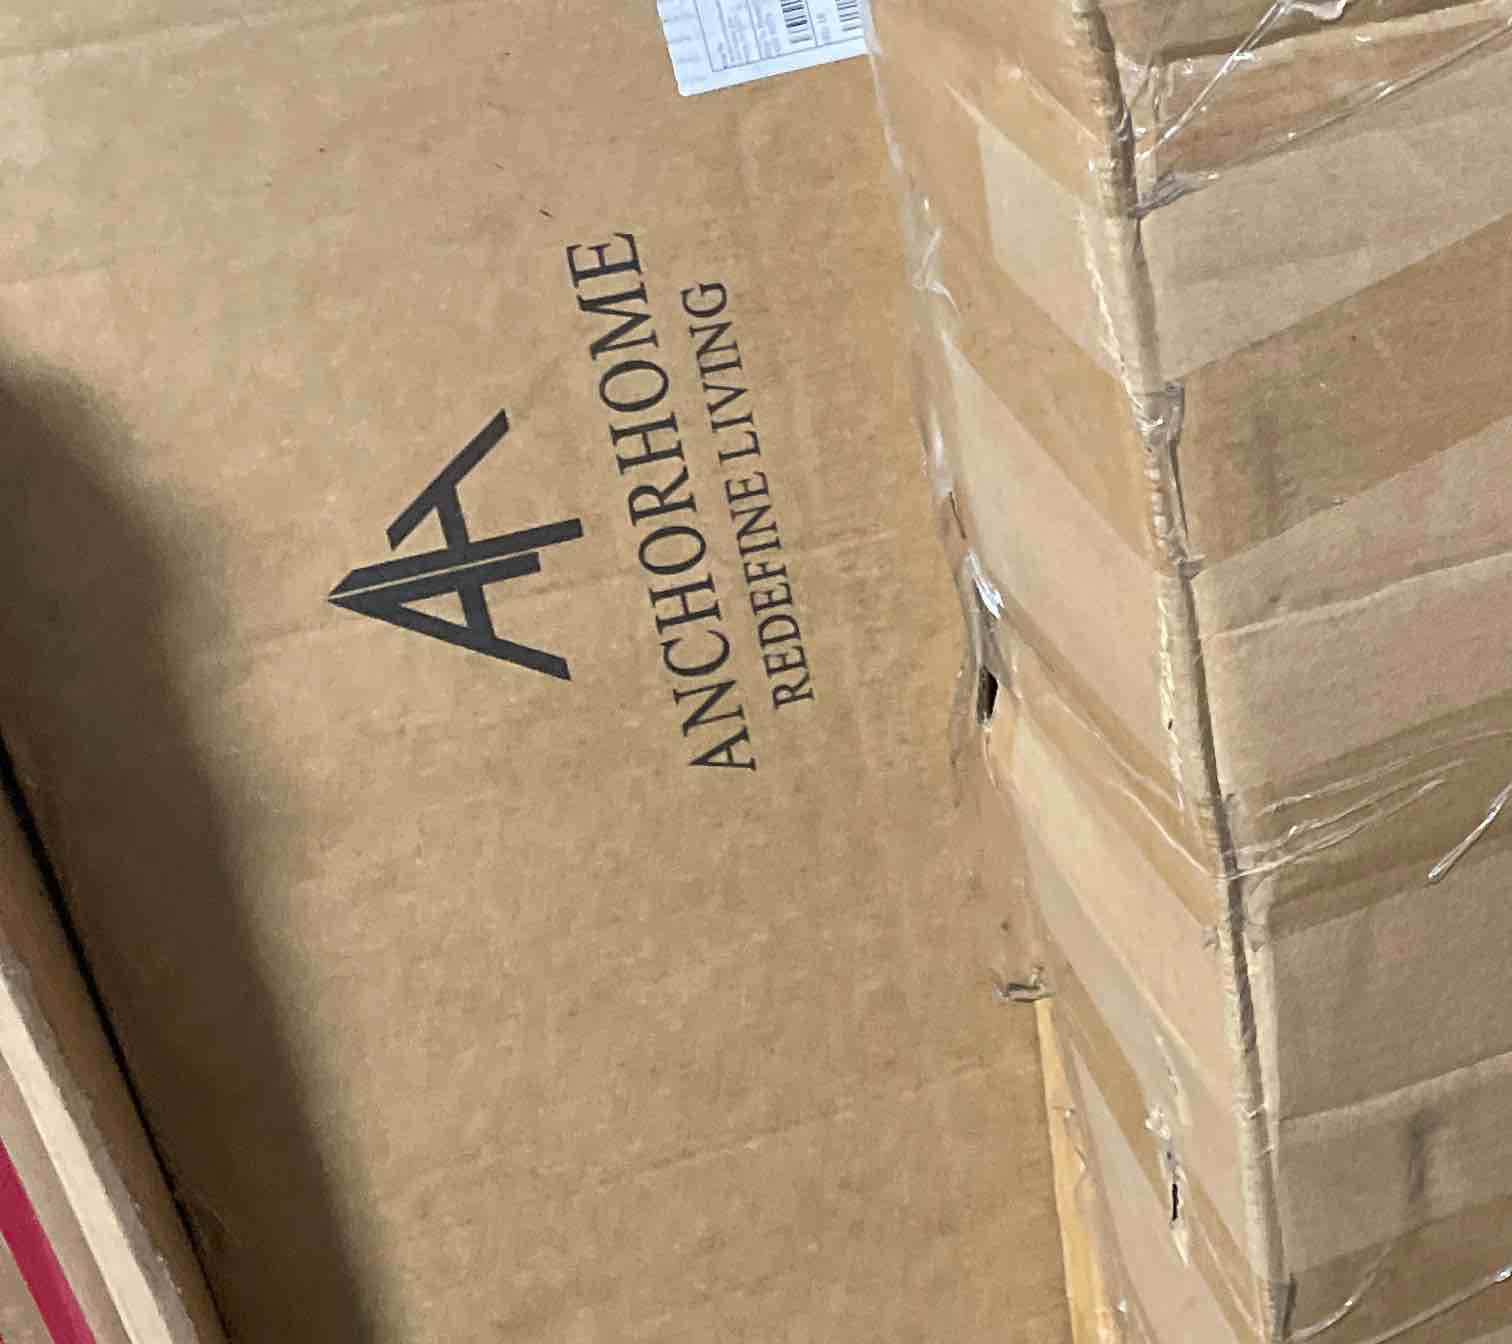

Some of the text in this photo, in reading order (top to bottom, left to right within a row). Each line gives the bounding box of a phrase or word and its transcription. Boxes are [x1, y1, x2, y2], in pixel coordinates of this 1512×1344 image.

[565, 231, 757, 772] ANCHORHOME
[681, 280, 816, 711] REDEFINE LIVING
